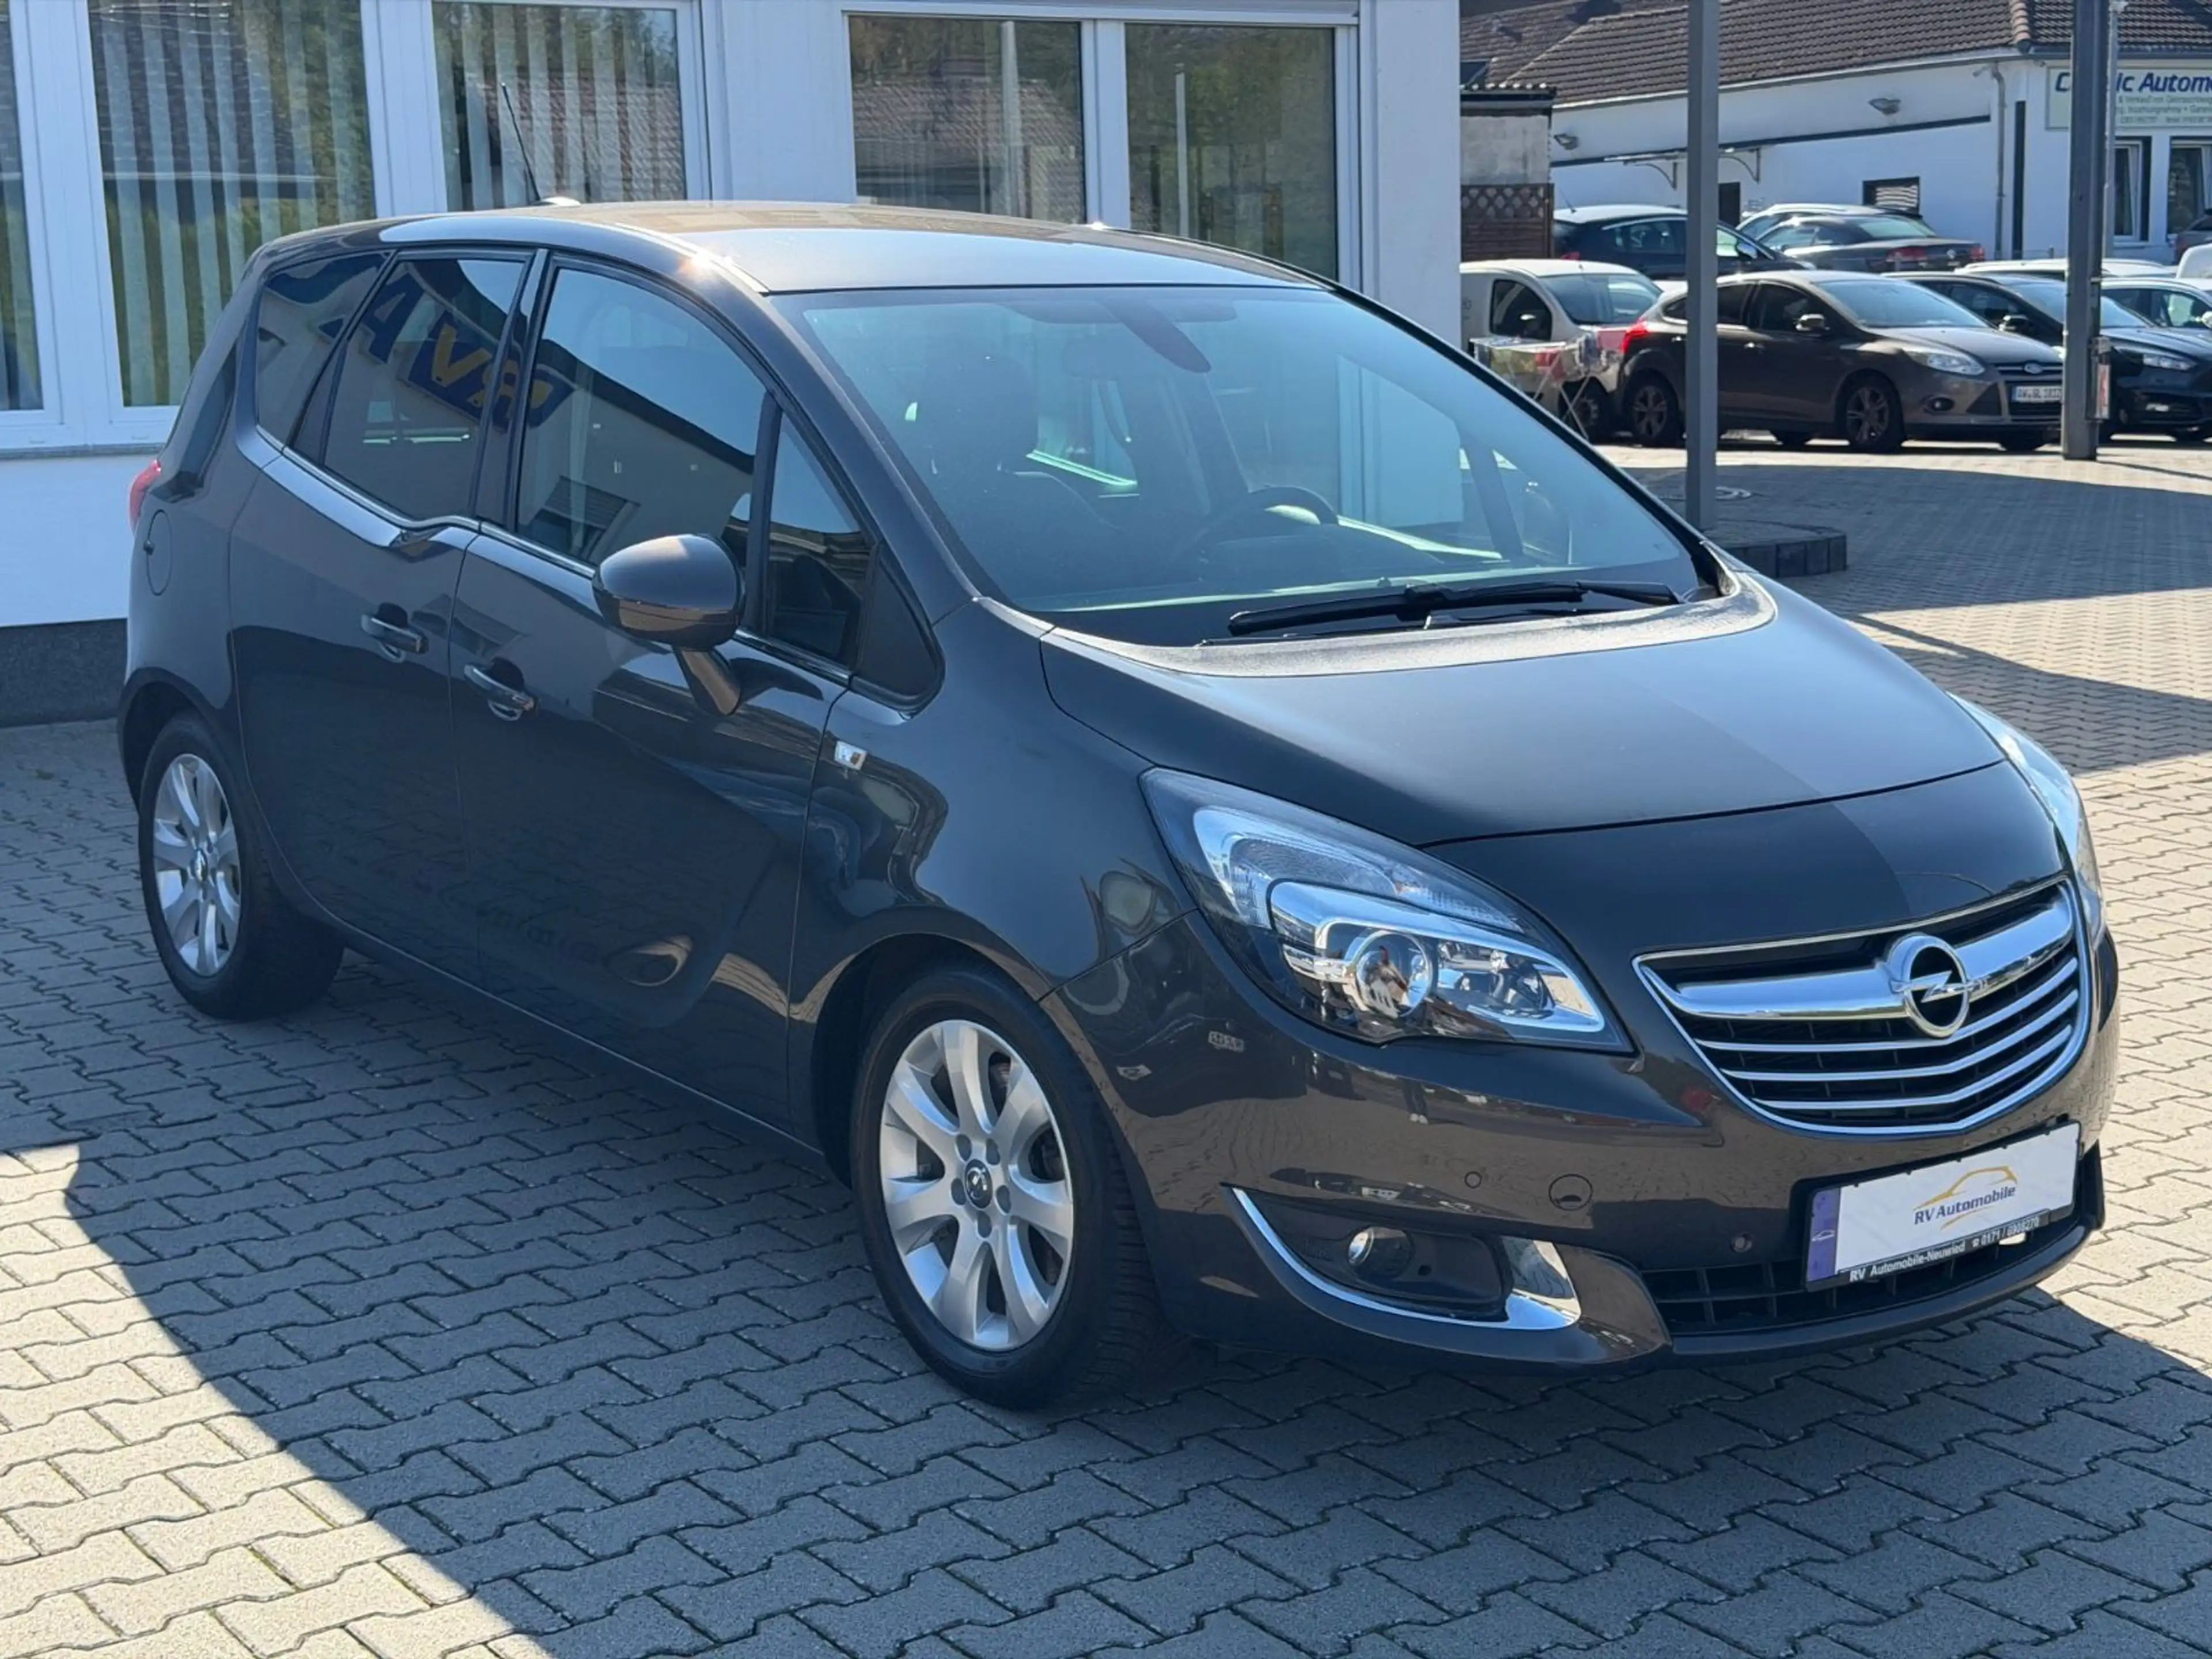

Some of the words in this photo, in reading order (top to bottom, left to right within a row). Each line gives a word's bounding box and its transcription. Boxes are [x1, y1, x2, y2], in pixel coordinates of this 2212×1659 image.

[1914, 1209, 1935, 1225] RV
[1936, 1186, 2016, 1219] Automobile
[1850, 1268, 1866, 1282] RV
